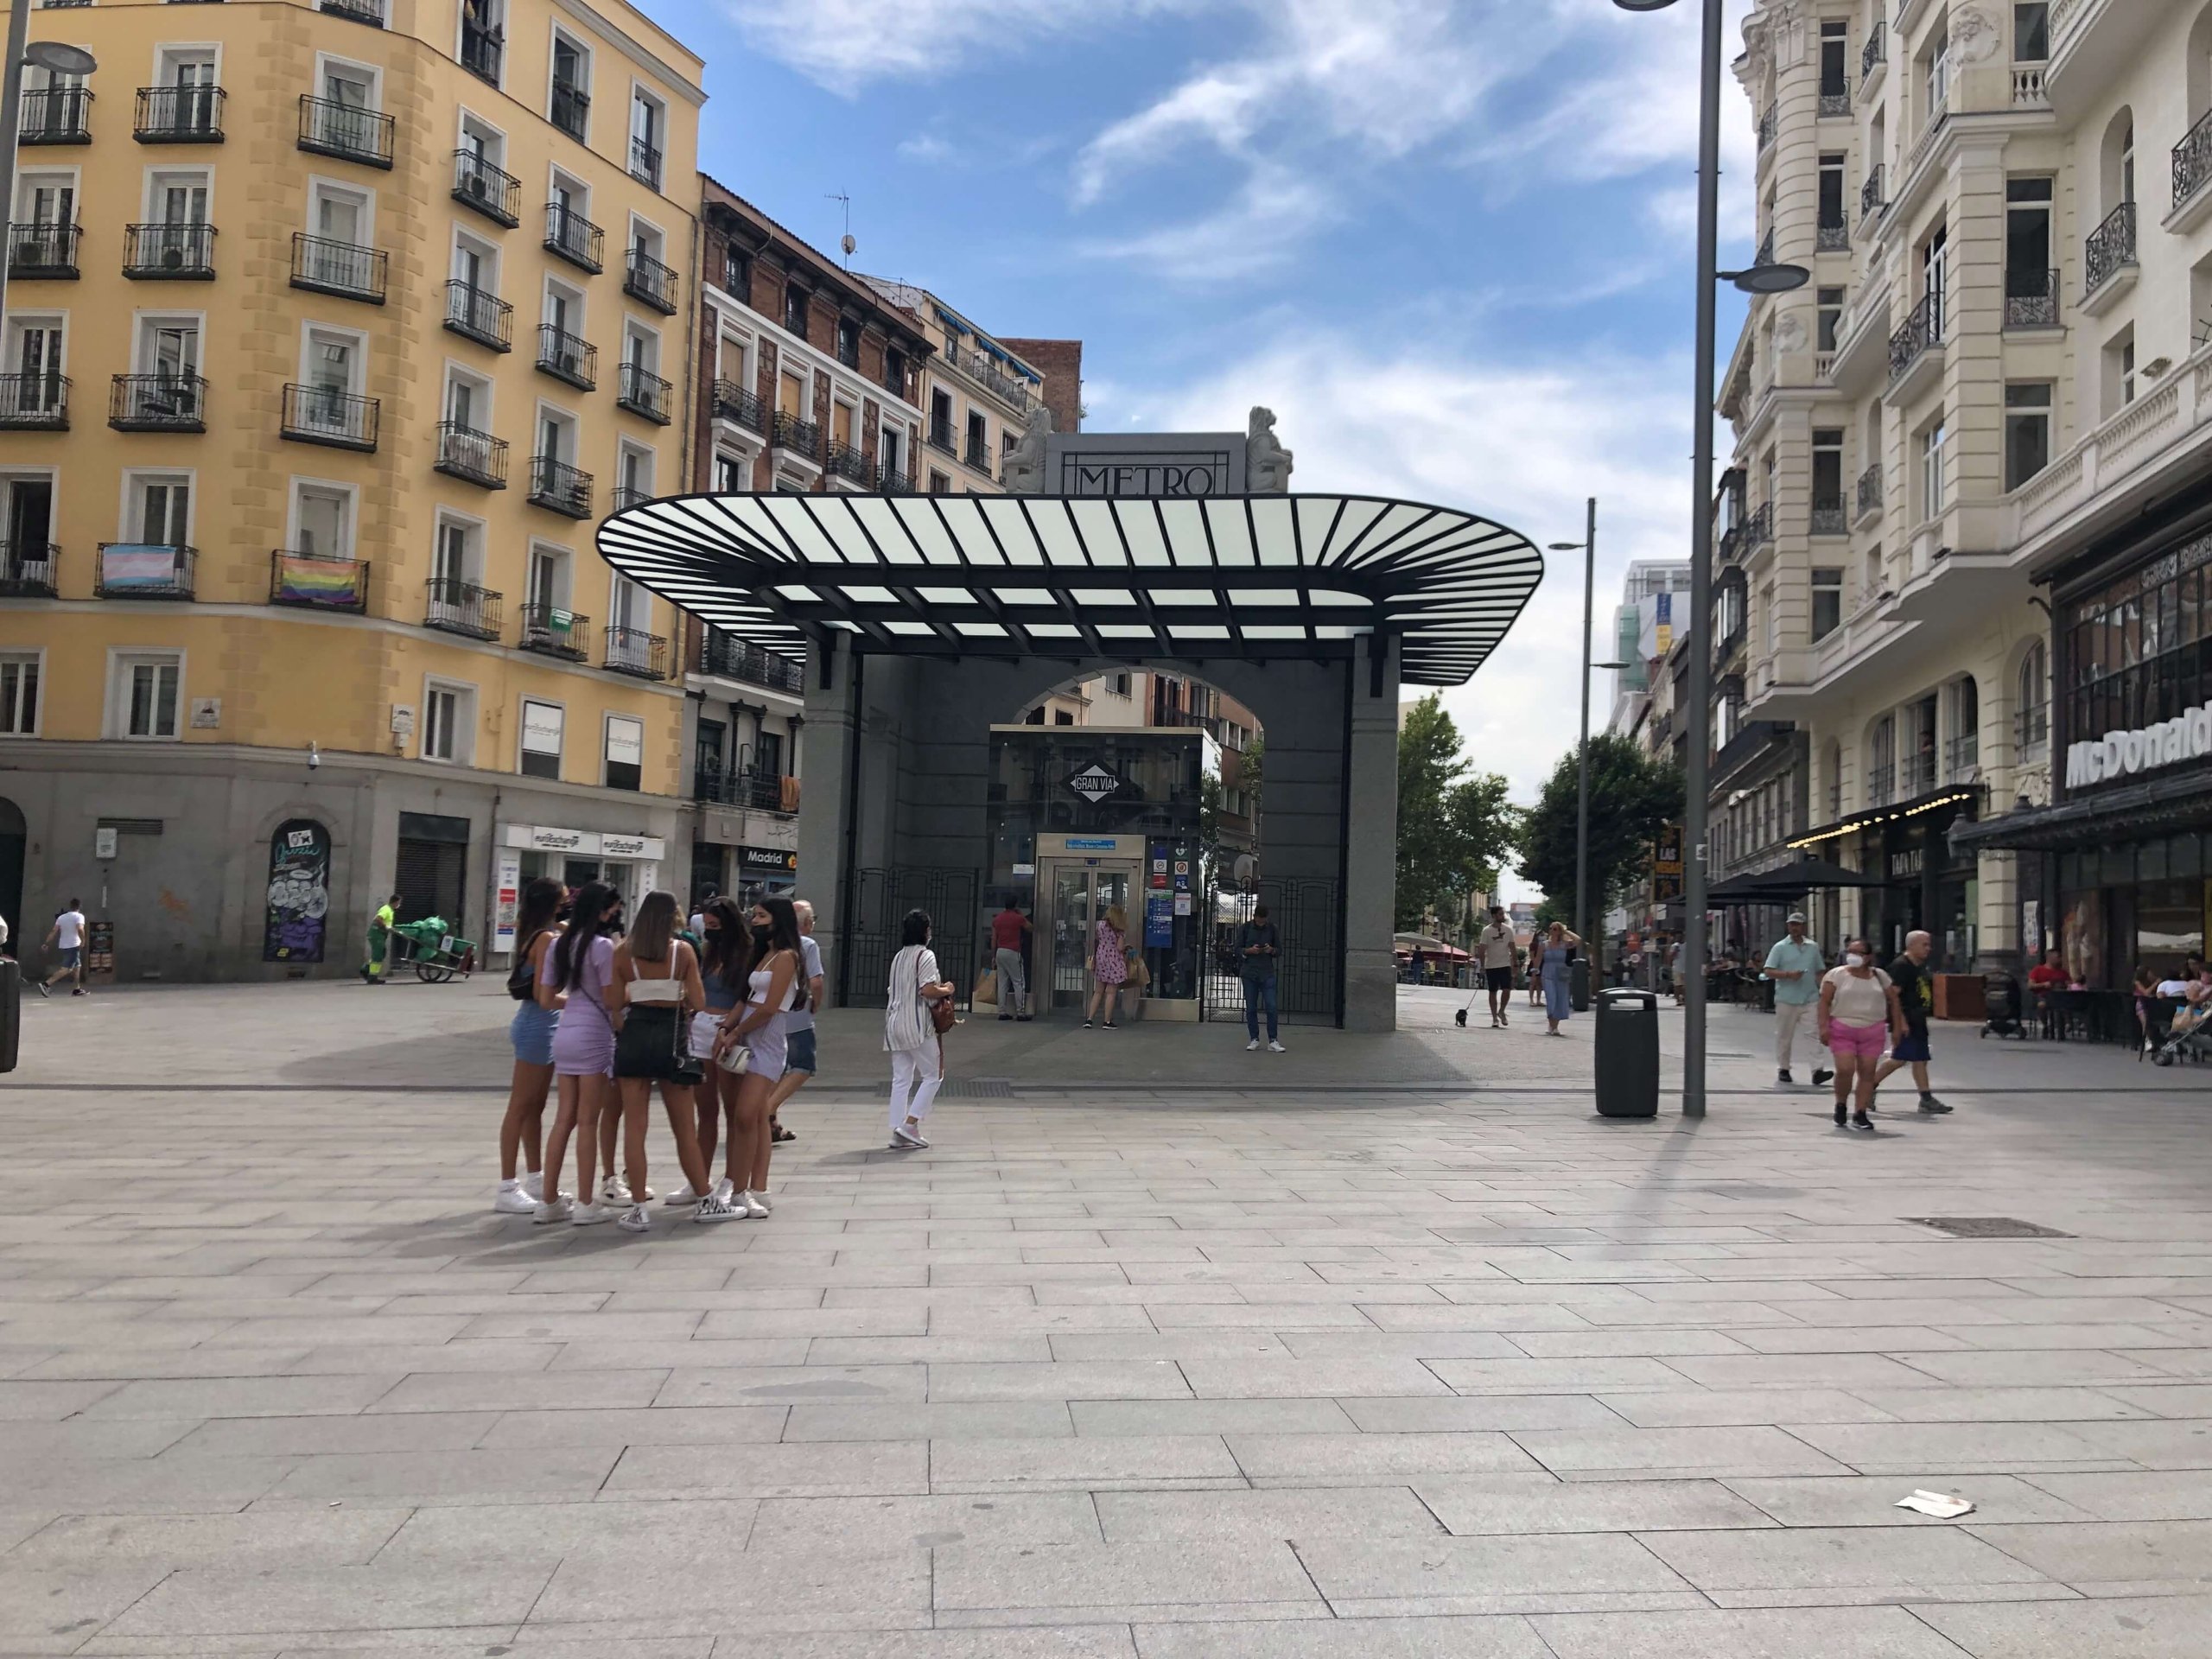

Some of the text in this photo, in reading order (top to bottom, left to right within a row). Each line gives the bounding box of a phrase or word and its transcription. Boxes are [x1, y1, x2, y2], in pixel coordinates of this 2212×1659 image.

[1079, 467, 1212, 495] METRO
[1076, 777, 1098, 790] GRAN
[747, 850, 783, 864] Madrid
